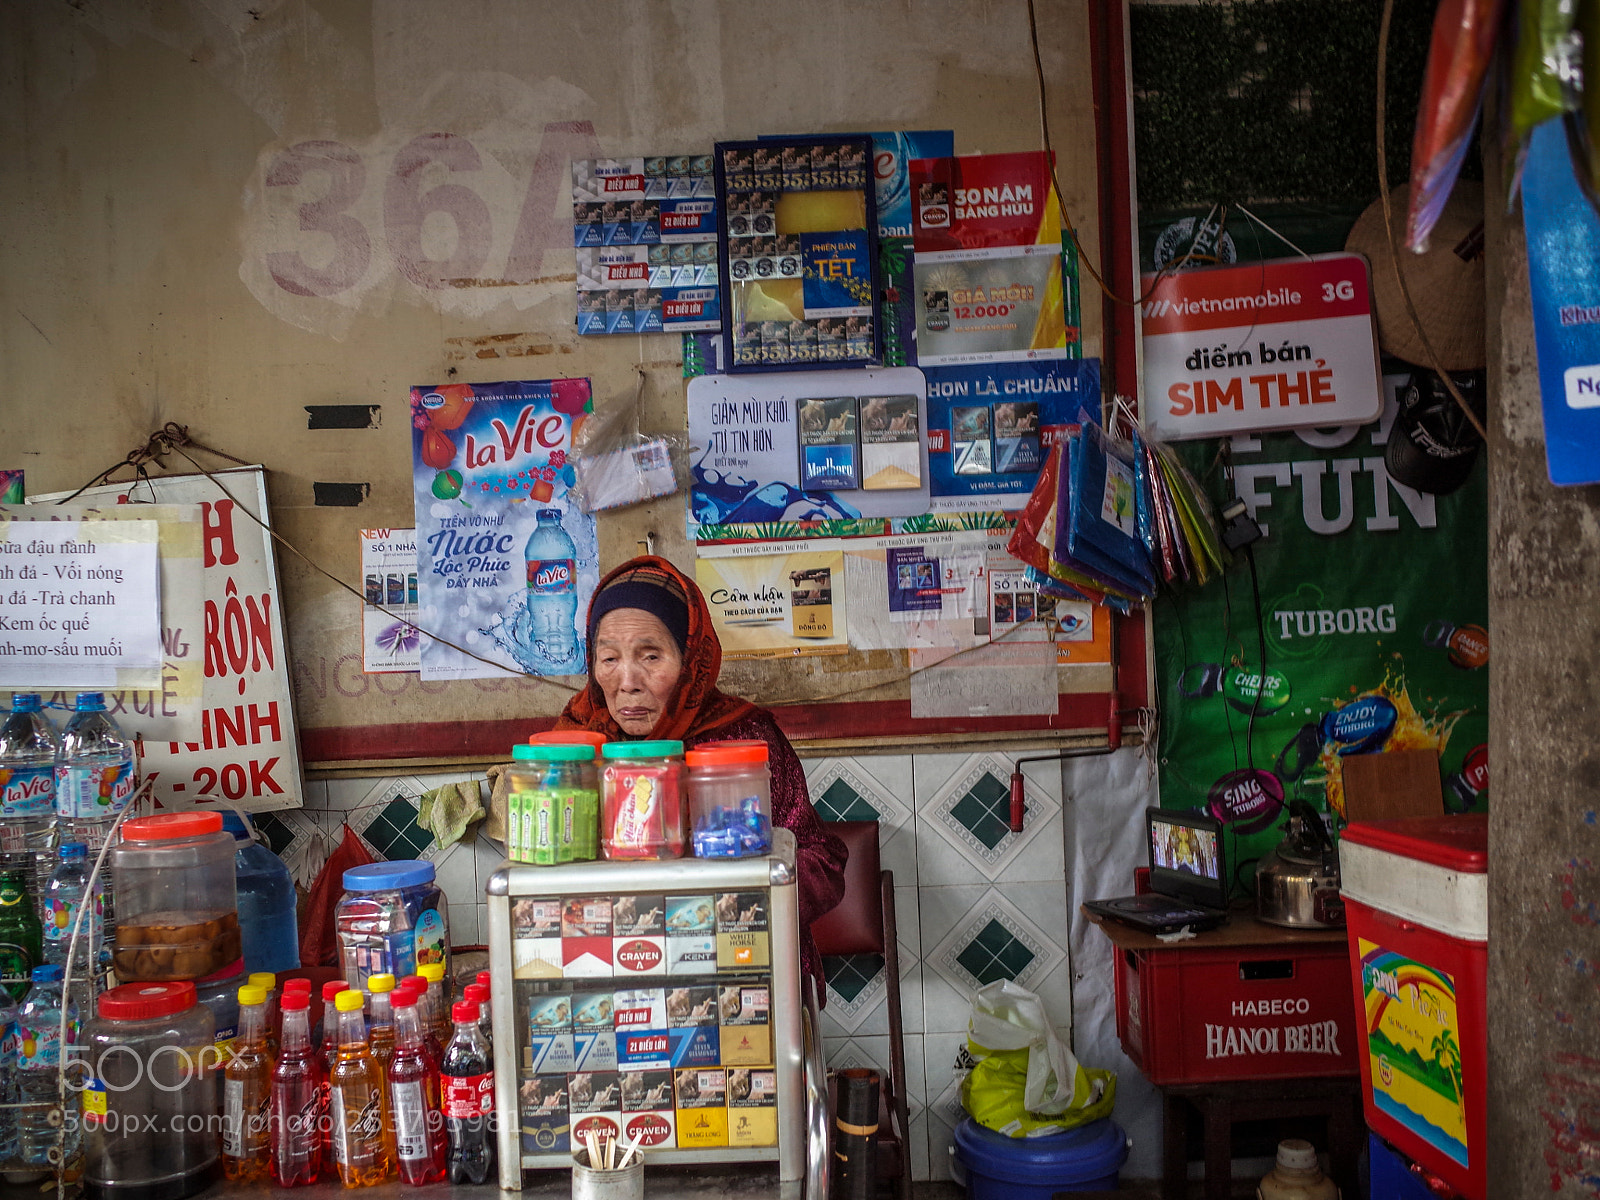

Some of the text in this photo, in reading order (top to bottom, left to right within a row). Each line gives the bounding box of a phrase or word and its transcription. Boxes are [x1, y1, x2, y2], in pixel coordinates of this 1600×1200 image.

[954, 187, 981, 206] 30
[814, 250, 856, 278] TẾT
[1172, 280, 1355, 316] vietnamobile 3G
[1185, 340, 1312, 371] điểm bán
[976, 376, 998, 395] LÀ
[1168, 377, 1245, 416] SIM
[1249, 358, 1336, 410] THẺ
[712, 397, 739, 426] GIẢM
[742, 396, 762, 425] MÙI
[730, 430, 750, 453] TIN
[806, 456, 853, 478] Marlboro
[1224, 456, 1437, 535] FUN
[440, 513, 466, 528] TIỀN
[27, 540, 54, 556] đậu
[388, 544, 393, 552] 1
[19, 561, 124, 583] đá Vối nóng
[467, 556, 511, 573] Phúc
[1014, 580, 1019, 590] 1
[9, 591, 26, 605] đá
[70, 591, 115, 605] chanh
[0, 612, 90, 634] Kem ốc quế
[1274, 604, 1397, 640] TUBORG
[84, 638, 122, 656] muối
[1335, 704, 1378, 725] ENJOY
[1333, 718, 1375, 737] TUBORG
[1223, 777, 1262, 807] SING
[1232, 792, 1266, 816] TUBORG
[619, 952, 659, 961] CRAVEN
[636, 961, 644, 970] A
[1232, 999, 1310, 1017] HABECO
[629, 1042, 638, 1052] 21
[1205, 1019, 1342, 1059] HANOI BEER
[646, 1135, 653, 1144] A
